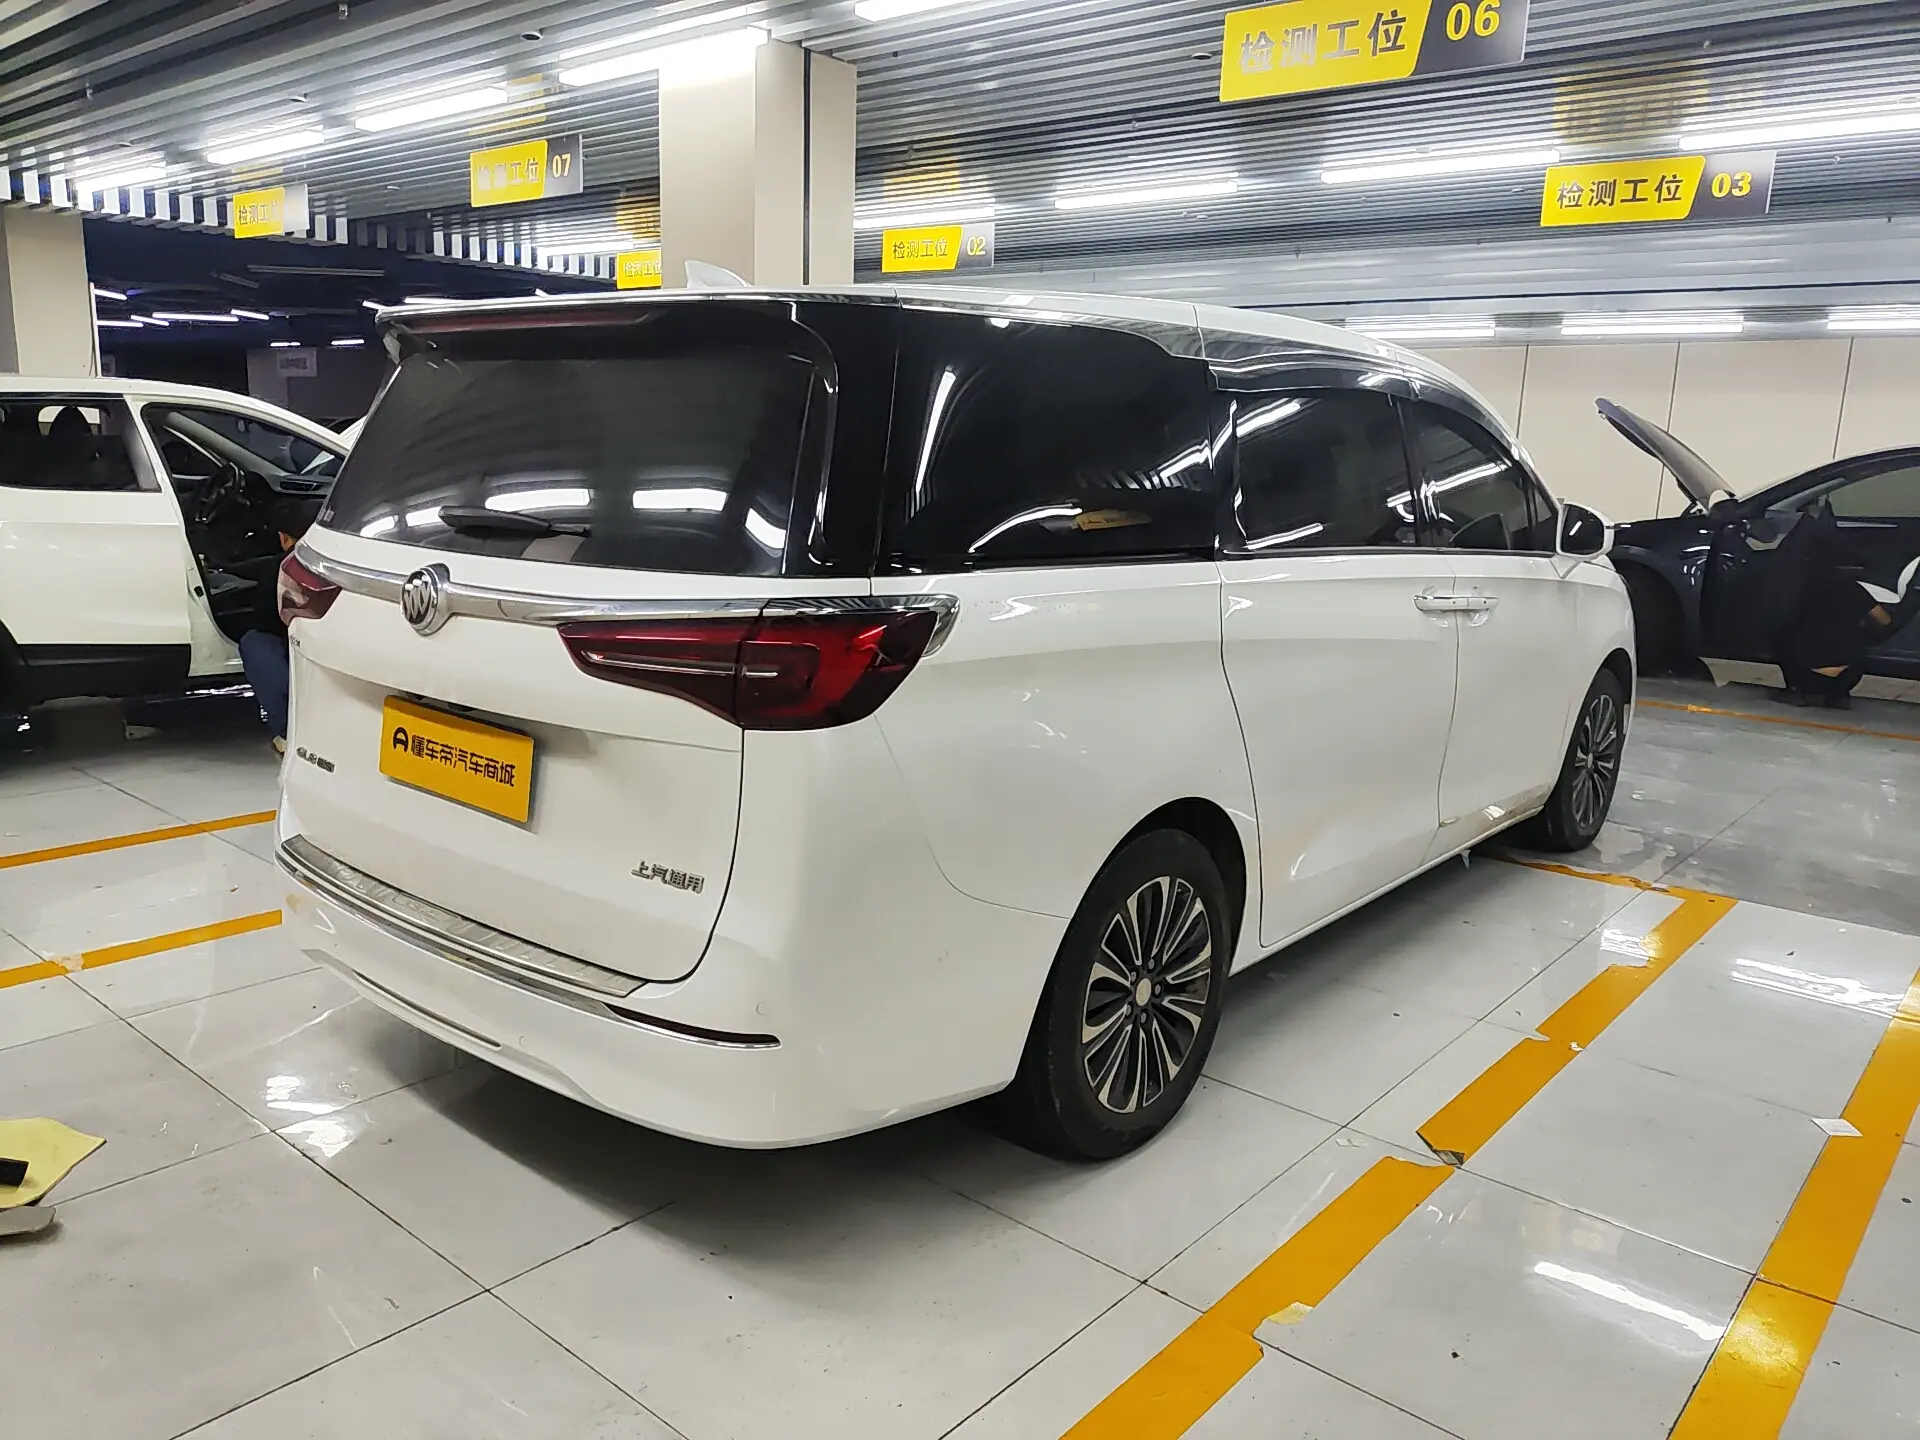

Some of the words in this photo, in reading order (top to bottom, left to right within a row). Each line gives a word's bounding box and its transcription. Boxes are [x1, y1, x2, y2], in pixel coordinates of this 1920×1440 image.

[1240, 9, 1407, 76] 检测工位
[1446, 0, 1500, 41] 06
[552, 153, 571, 178] 07
[1557, 174, 1683, 209] 检测工位
[1711, 171, 1752, 198] 03
[892, 238, 948, 259] 检测工位
[966, 235, 986, 256] 02
[411, 734, 517, 787] 懂车帝汽车商城
[631, 859, 705, 894] 上汽通用
